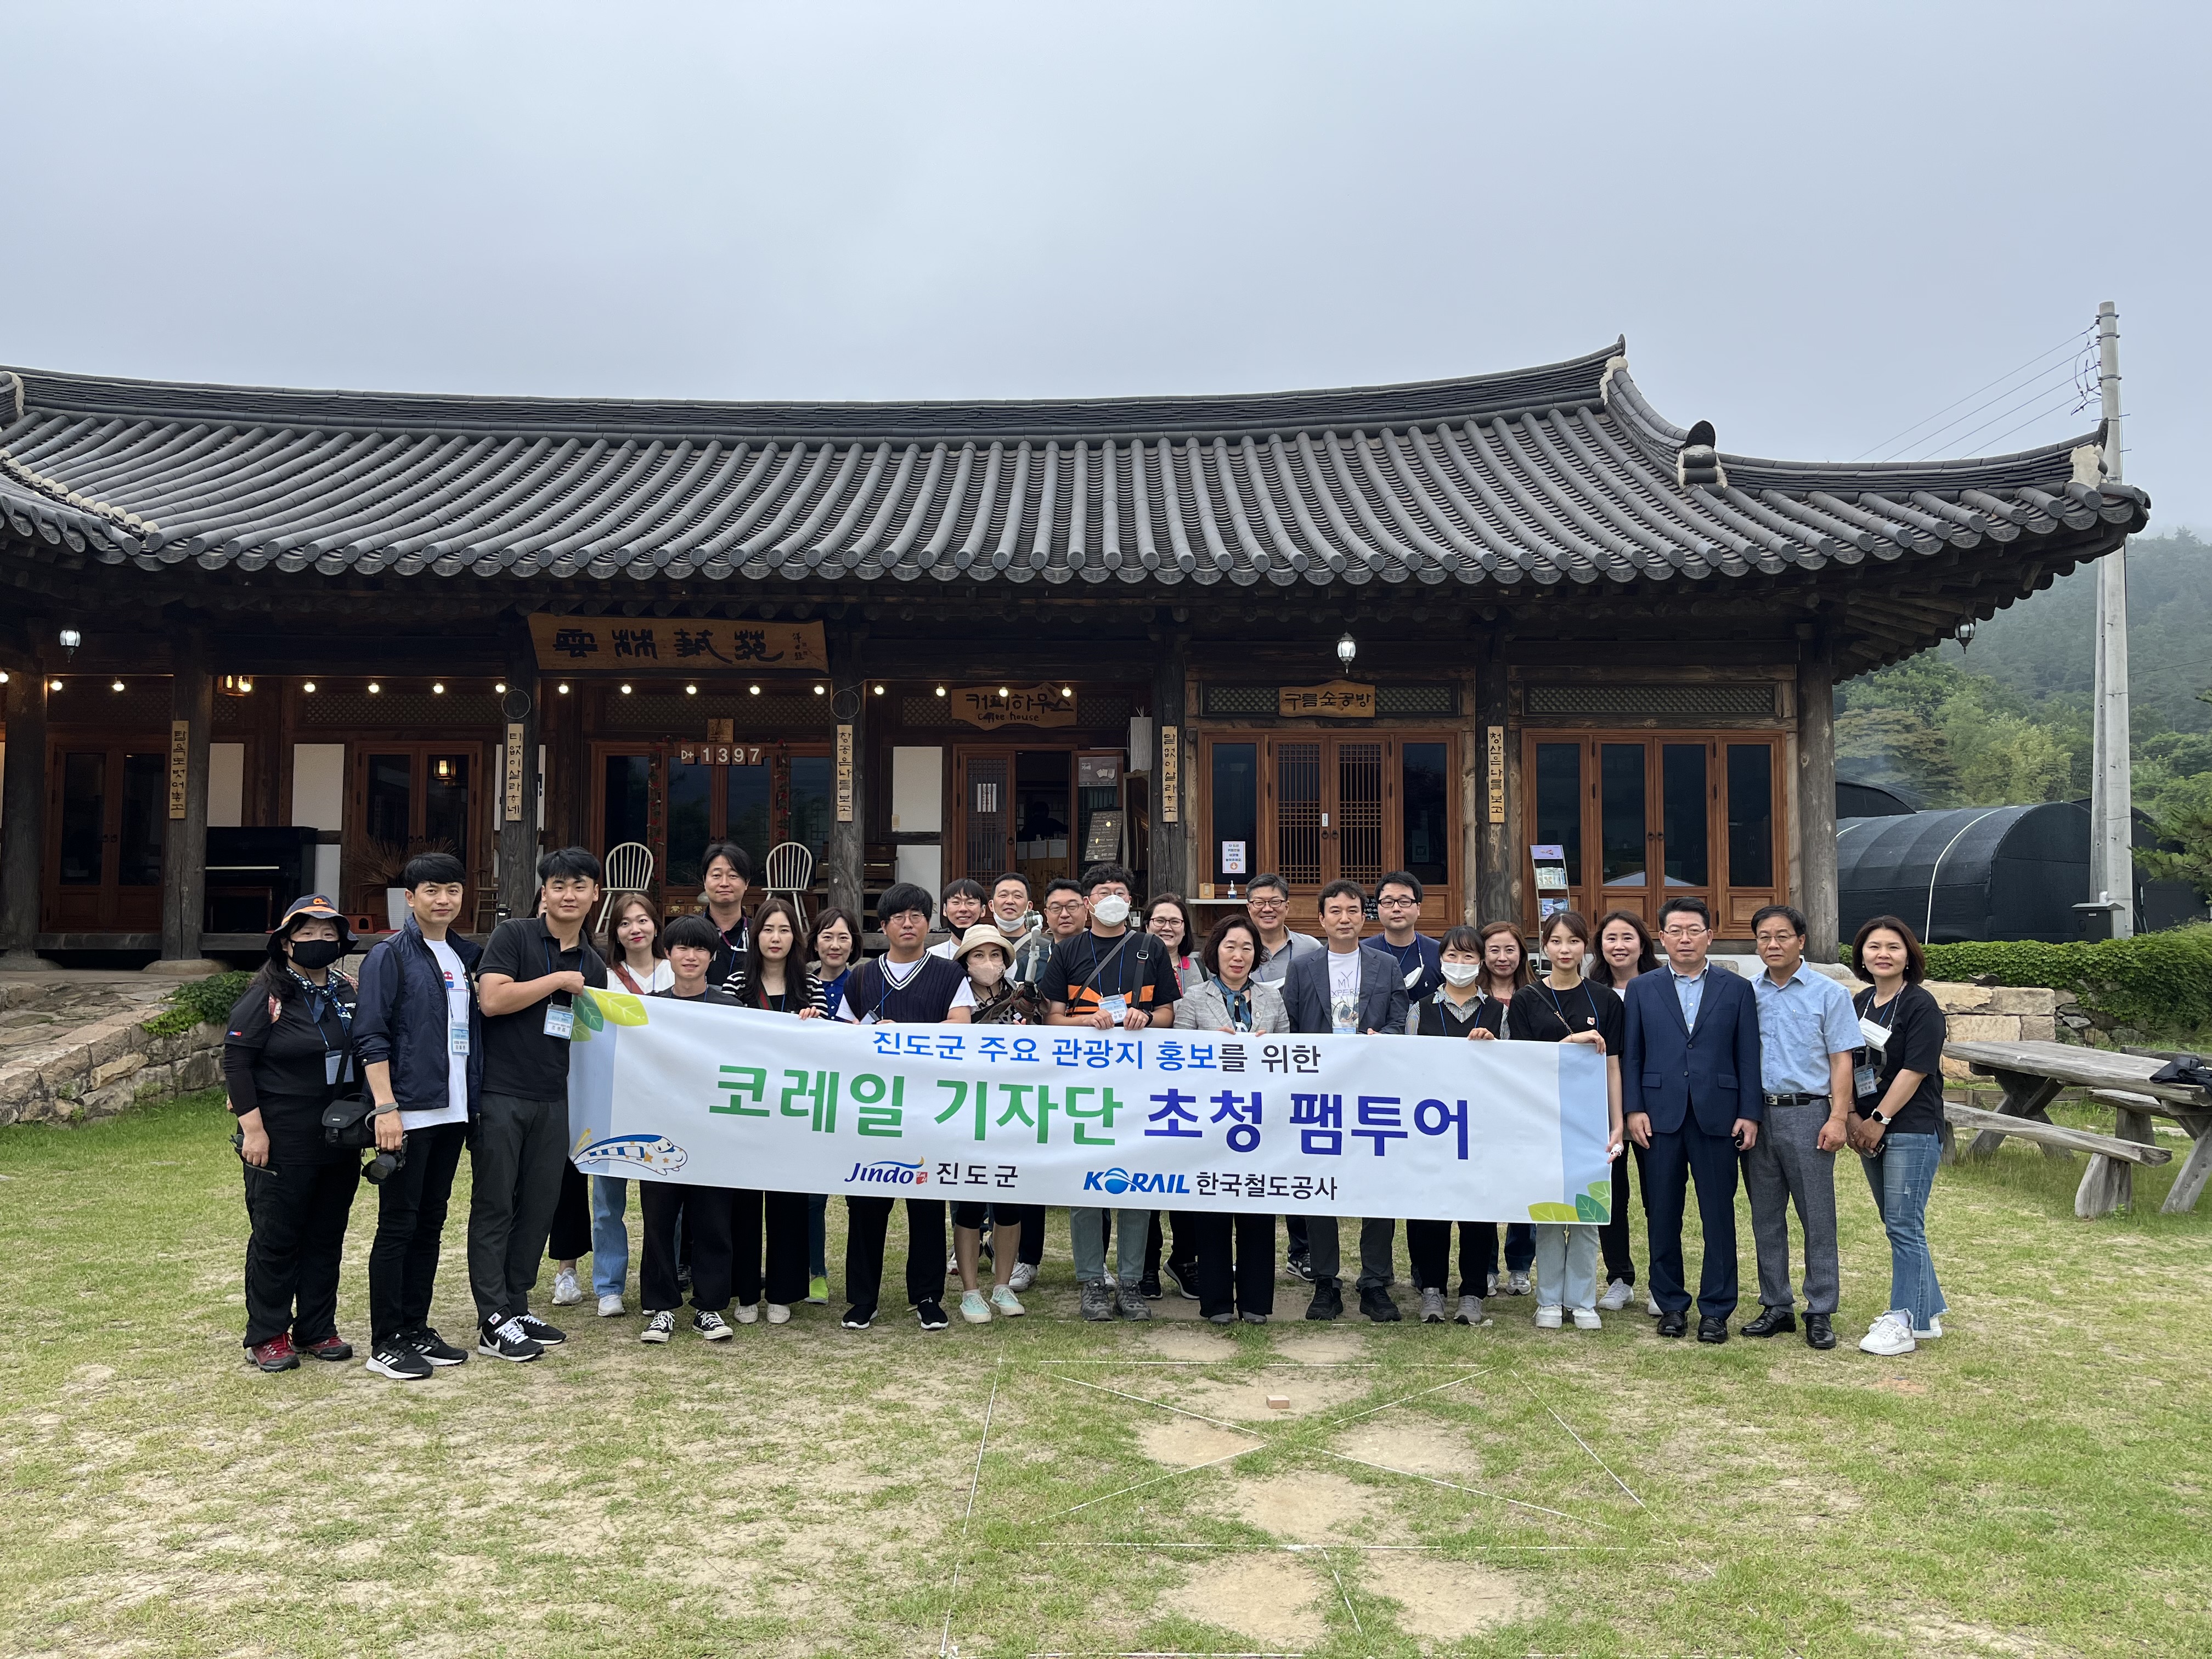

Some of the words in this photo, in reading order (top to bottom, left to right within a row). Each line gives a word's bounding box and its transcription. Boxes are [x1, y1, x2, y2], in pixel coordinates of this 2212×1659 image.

[966, 692, 1074, 714] 커피하우스
[1285, 691, 1371, 710] 구름숲공방
[1009, 712, 1040, 721] house
[681, 750, 694, 760] D+
[703, 747, 760, 763] 1397
[873, 1031, 966, 1060] 진도군
[978, 1037, 1040, 1063] 주요
[1052, 1039, 1143, 1070] 관광지
[1156, 1041, 1248, 1073] 홍보를
[1261, 1044, 1322, 1074] 위한
[709, 1065, 905, 1138] 코레일
[935, 1080, 1123, 1146] 기자단
[1144, 1088, 1263, 1153] 초청
[1289, 1093, 1469, 1160] 팸투어
[844, 1163, 914, 1184] Jindo
[936, 1163, 1018, 1188] 진도군
[1084, 1167, 1190, 1194] KORAIL
[1197, 1172, 1338, 1201] 한국철도공사
